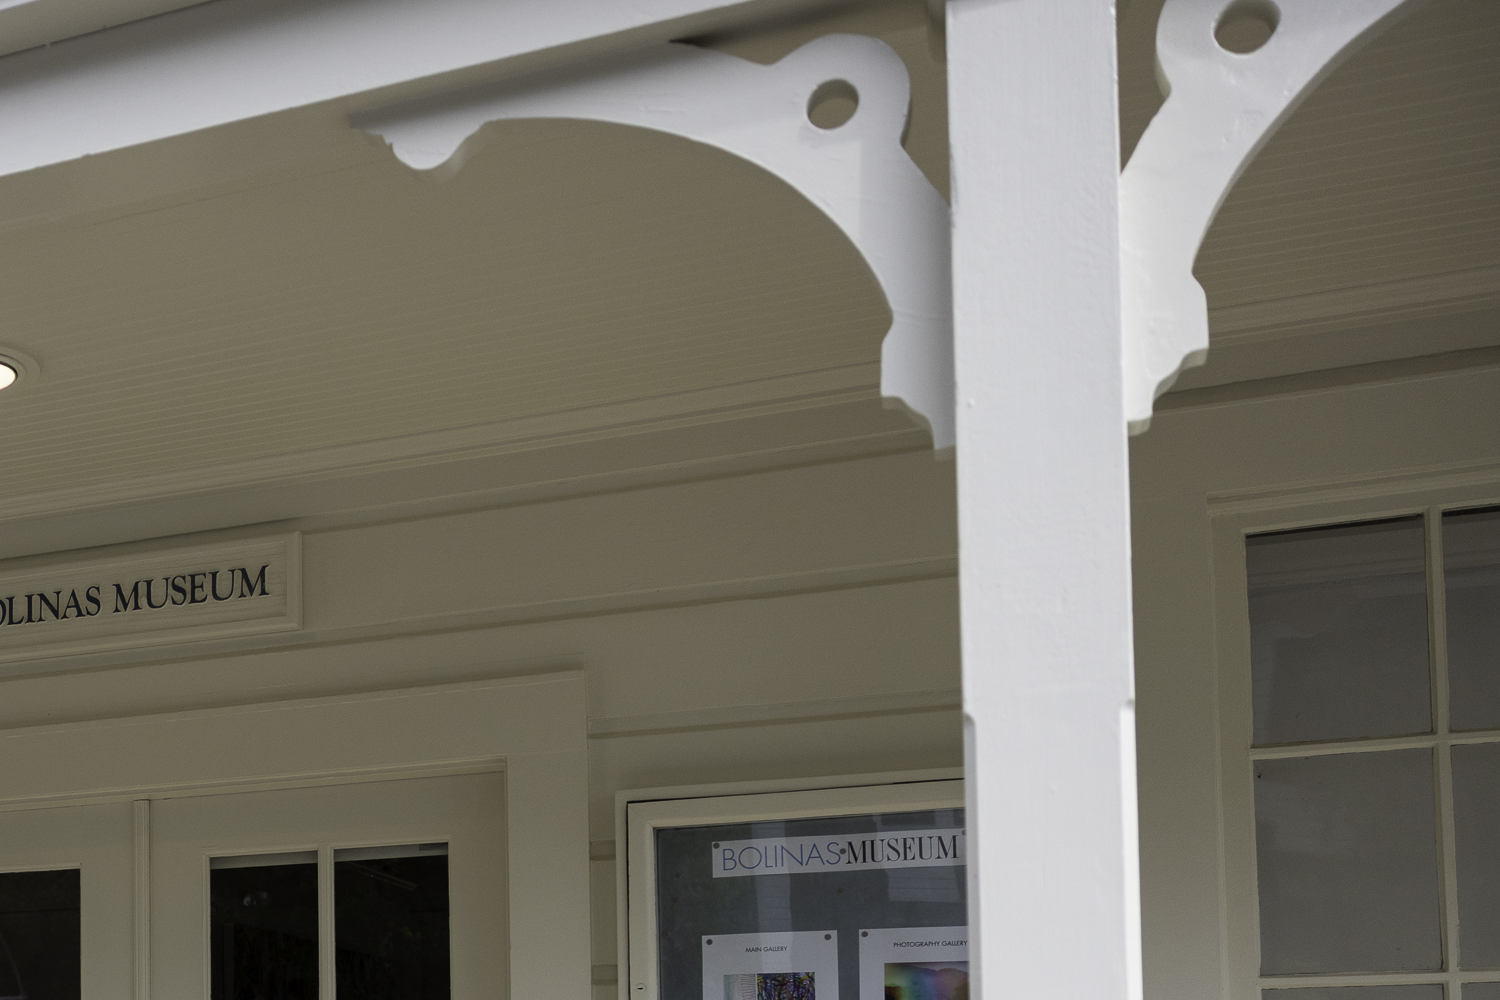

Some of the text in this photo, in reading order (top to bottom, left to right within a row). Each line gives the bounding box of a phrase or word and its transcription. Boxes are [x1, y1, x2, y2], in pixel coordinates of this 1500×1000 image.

[112, 565, 269, 613] MUSEUM
[722, 835, 959, 870] BOLINAS MUSEUM
